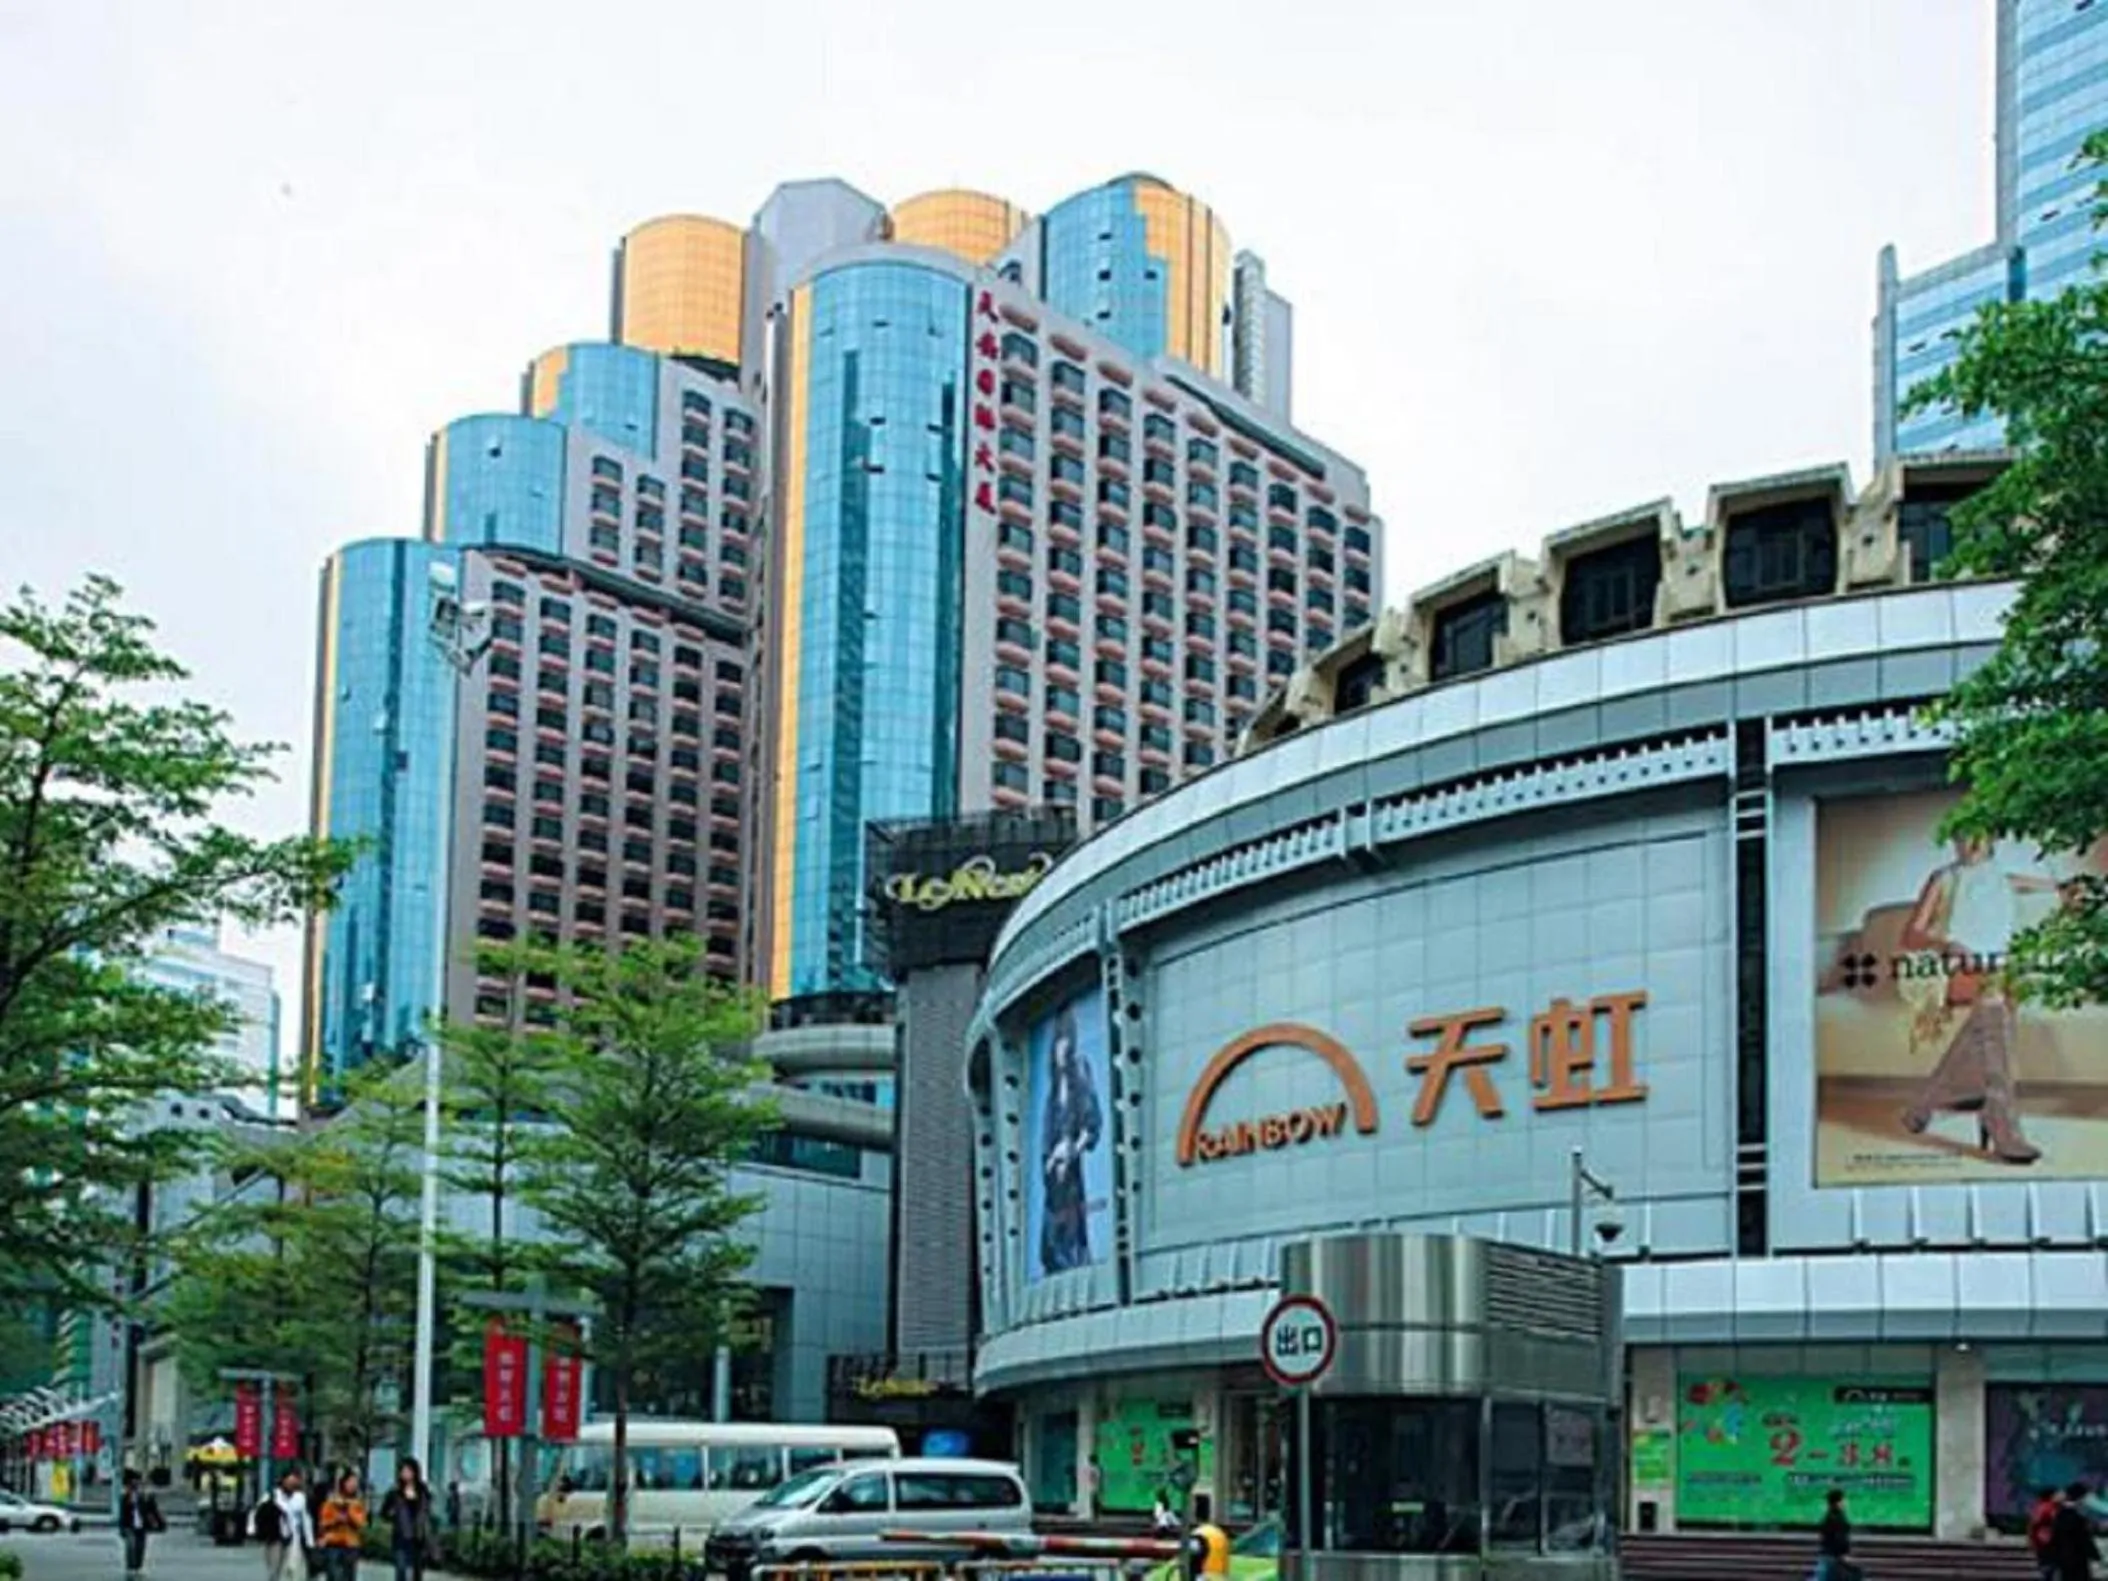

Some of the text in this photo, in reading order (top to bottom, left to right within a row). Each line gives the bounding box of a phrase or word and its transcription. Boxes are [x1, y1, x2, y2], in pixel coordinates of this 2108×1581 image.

[1406, 990, 1649, 1128] 天虹
[1197, 1102, 1347, 1162] RAINBOW
[1276, 1323, 1323, 1356] 出口
